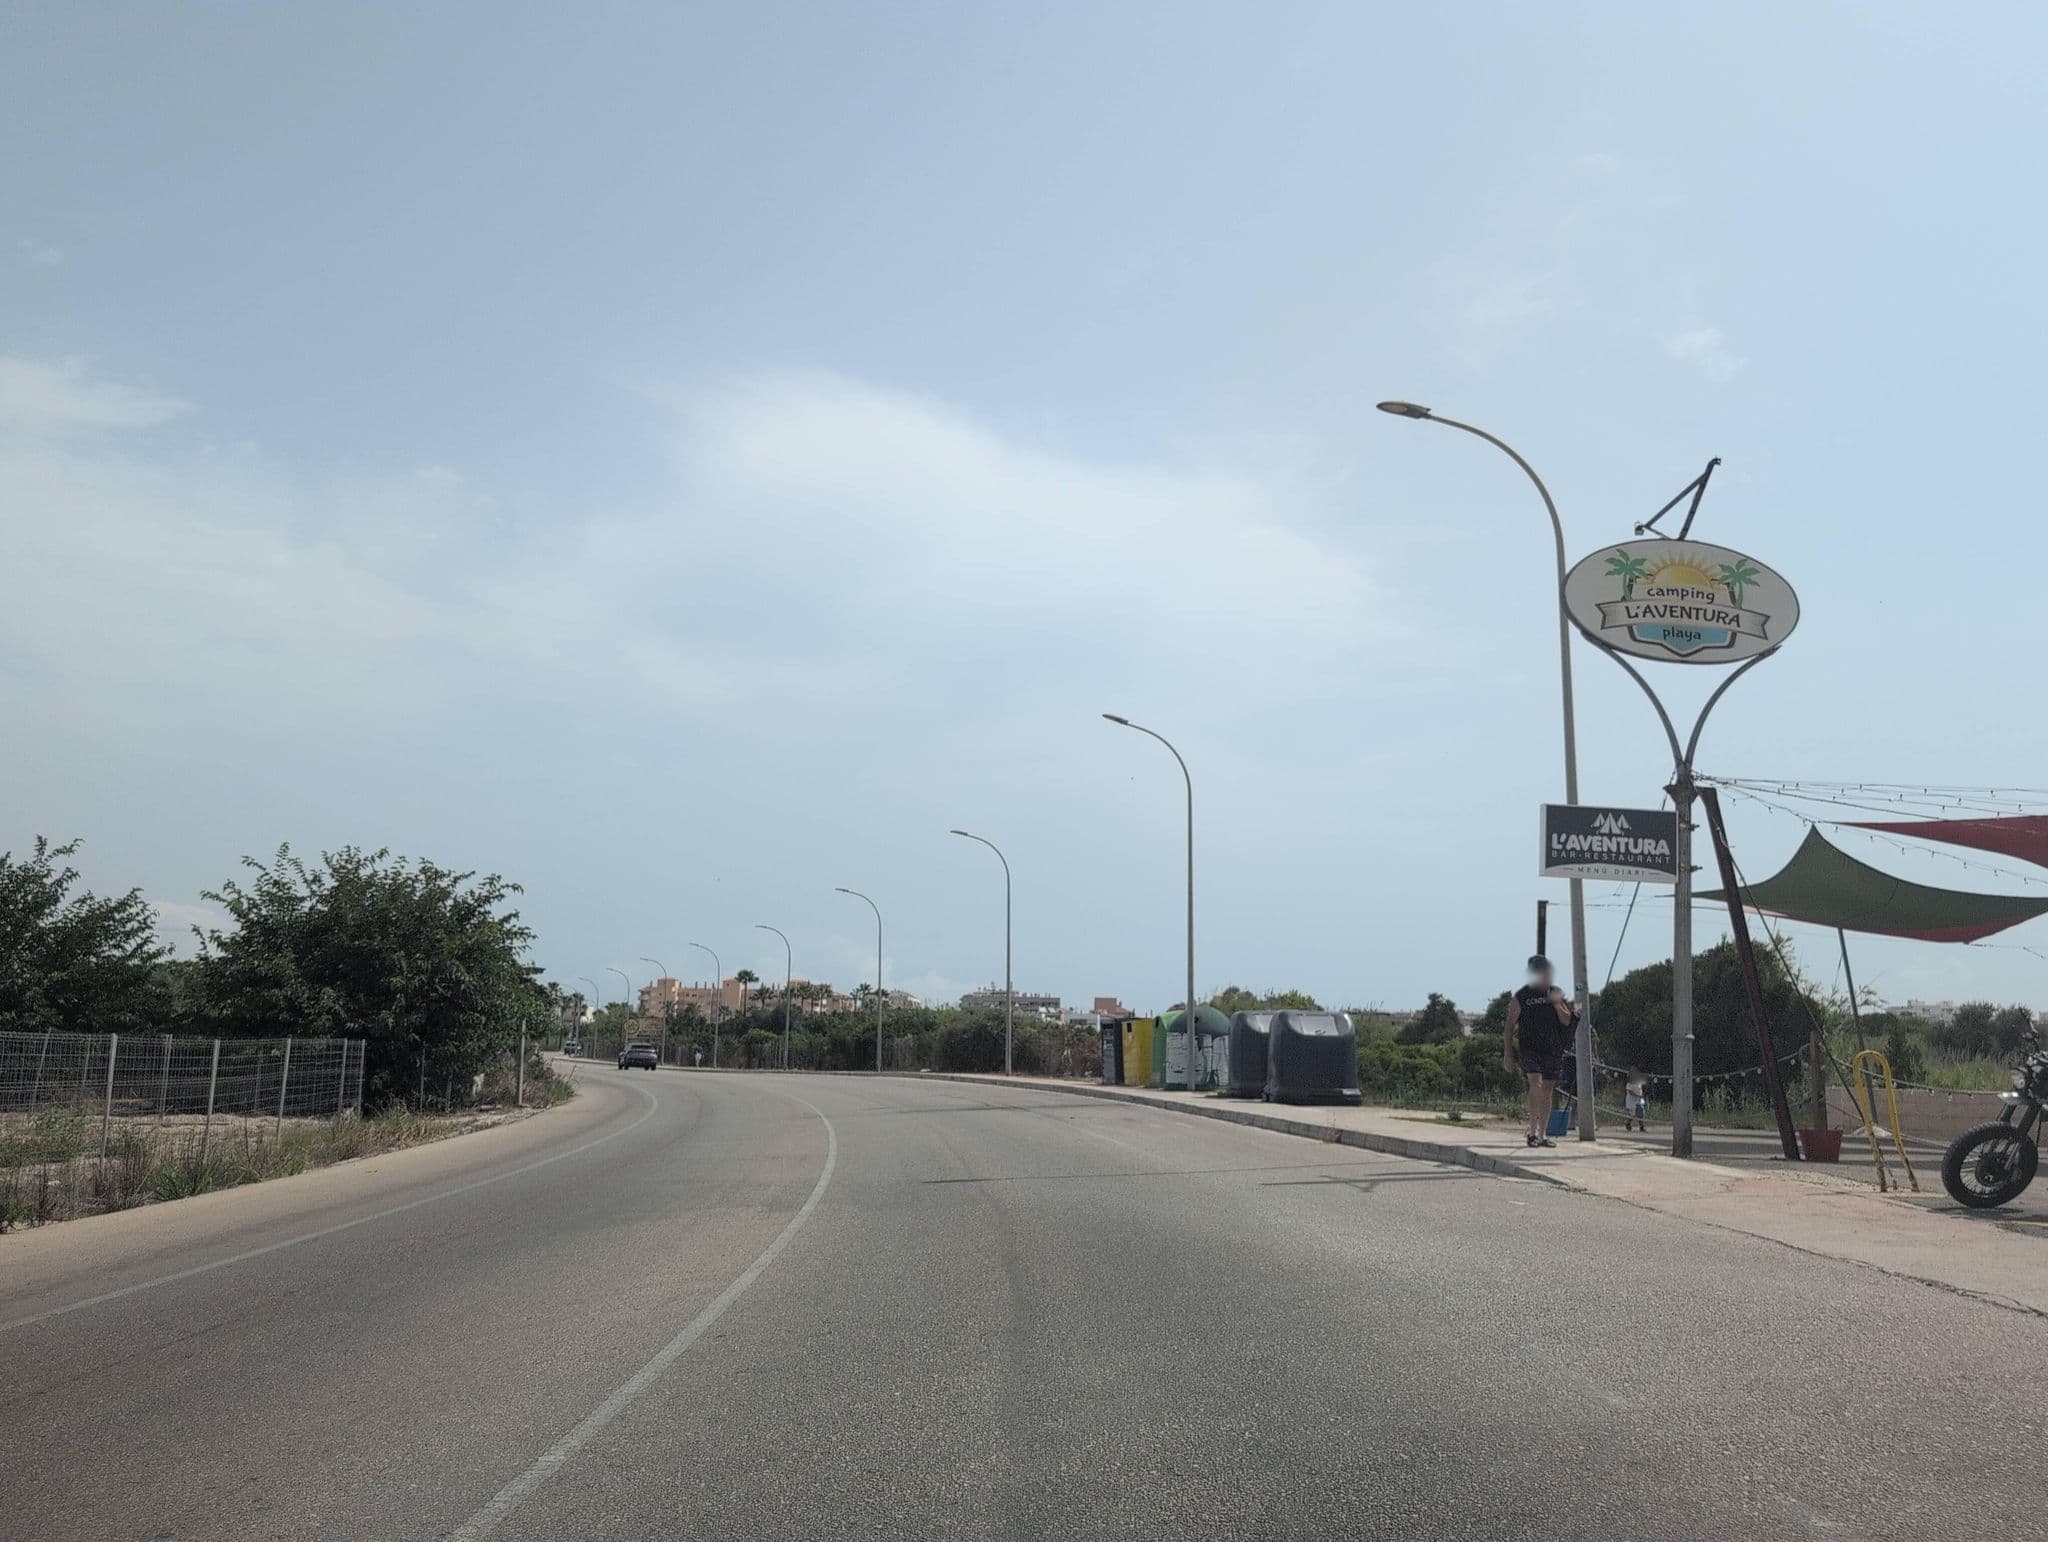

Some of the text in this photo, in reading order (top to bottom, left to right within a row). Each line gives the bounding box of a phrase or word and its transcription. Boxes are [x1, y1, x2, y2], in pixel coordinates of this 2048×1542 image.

[1647, 587, 1715, 604] camping
[1625, 605, 1741, 628] L'AVENTURA
[1662, 627, 1701, 641] playa
[1551, 833, 1670, 856] L'AVENTURA
